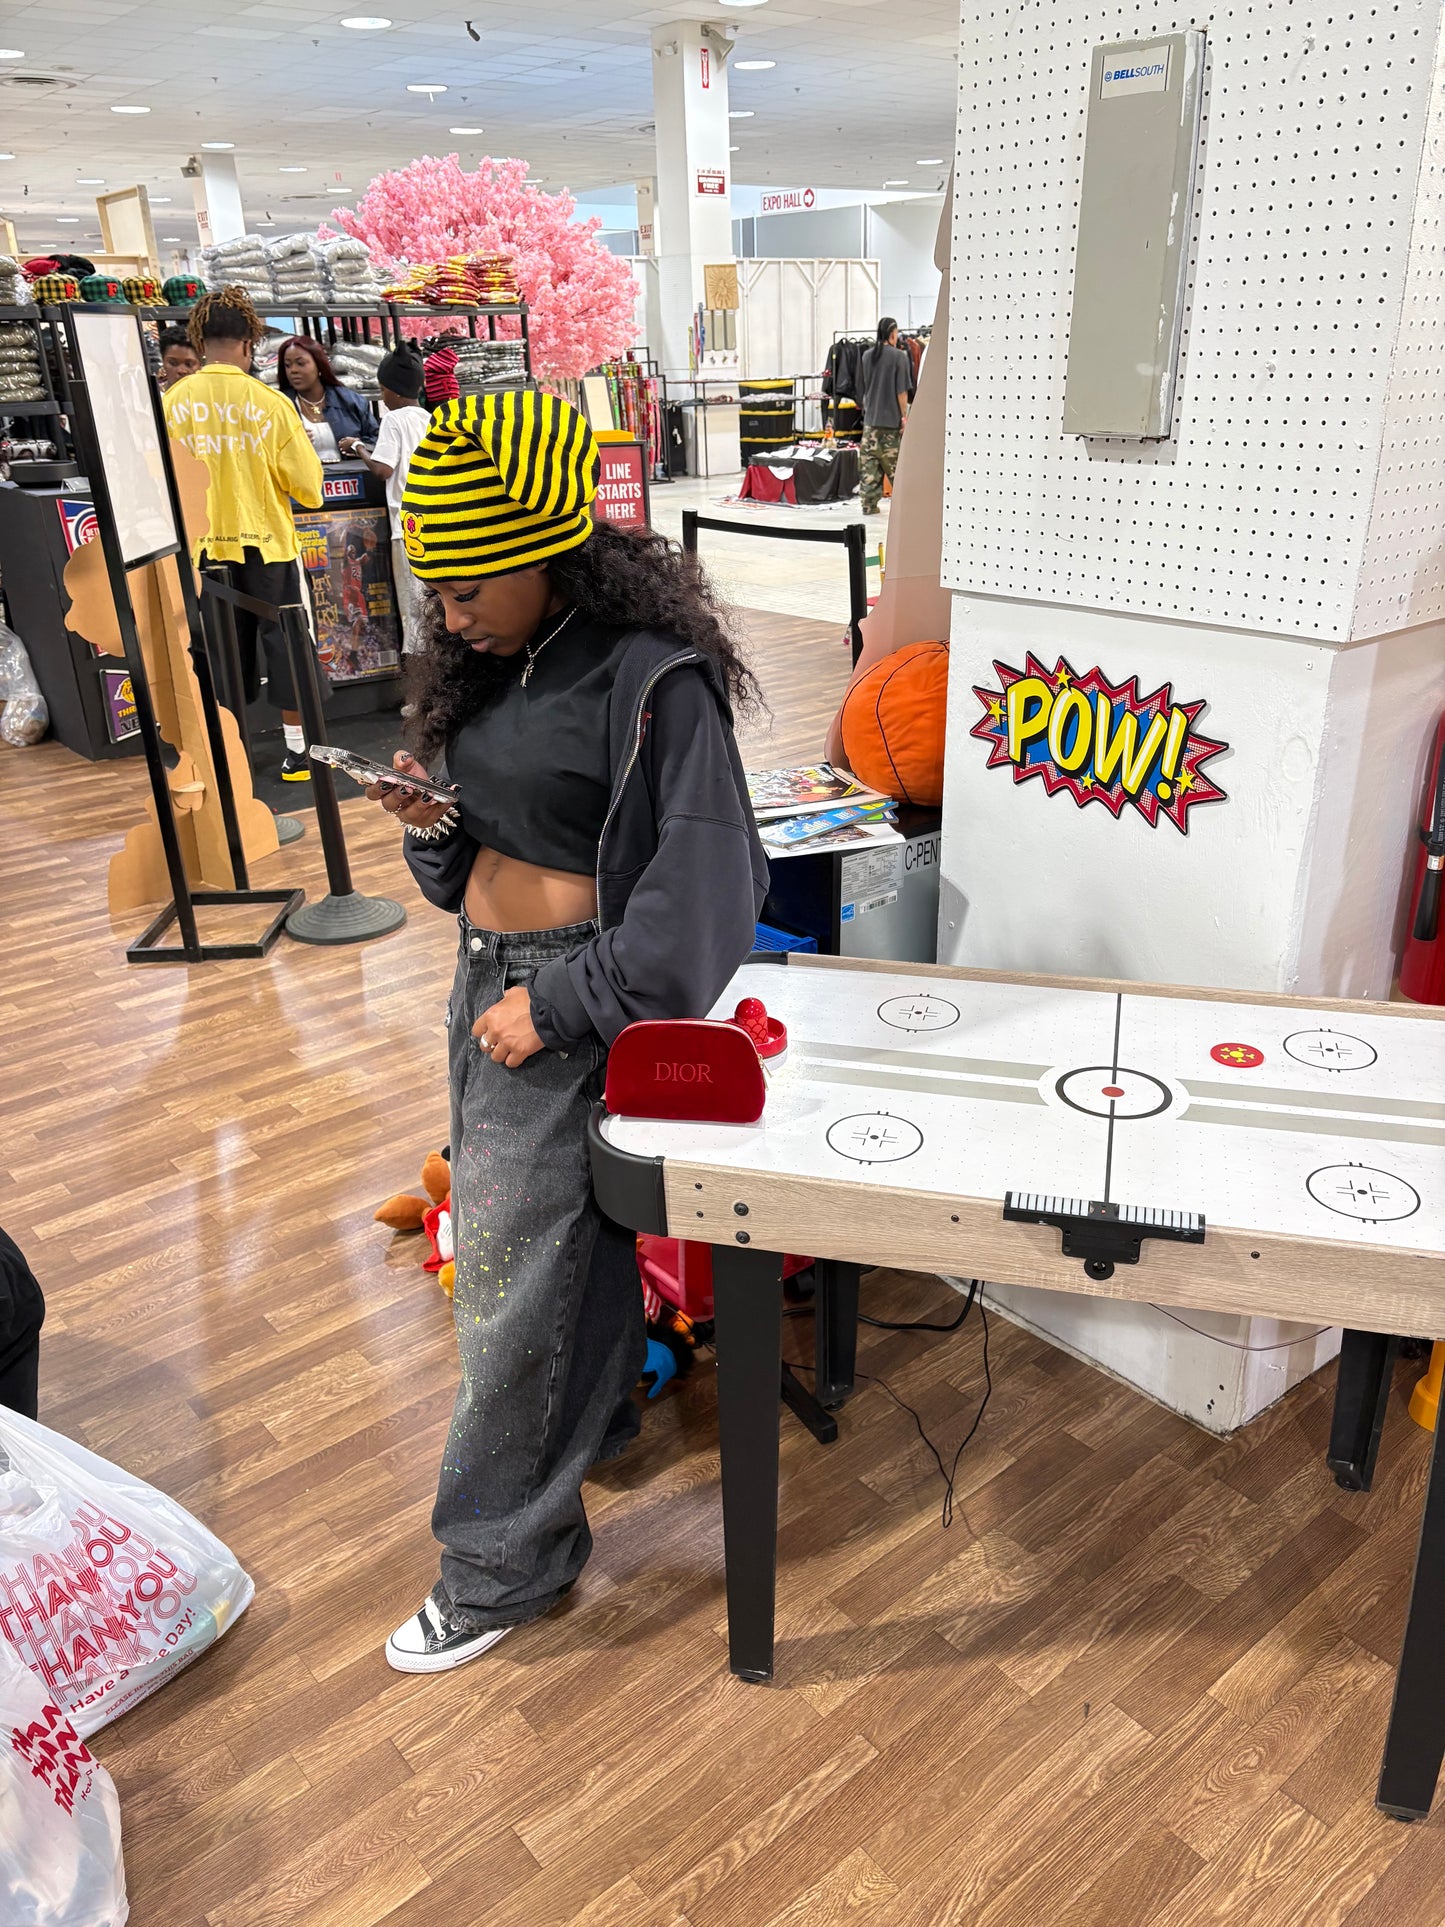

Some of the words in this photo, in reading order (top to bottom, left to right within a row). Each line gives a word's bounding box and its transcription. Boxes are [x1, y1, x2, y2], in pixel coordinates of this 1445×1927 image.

[1113, 64, 1165, 80] BELLSOUTH
[763, 195, 781, 211] EXPO
[784, 192, 802, 209] HALL
[605, 463, 632, 480] LINE
[323, 479, 359, 497] RENT
[598, 482, 642, 500] STARTS
[605, 503, 637, 519] HERE
[1007, 676, 1188, 803] POW!
[653, 1062, 714, 1084] DIOR
[118, 1549, 178, 1621] YOU
[135, 1568, 198, 1638] YOU
[69, 1679, 116, 1714] Have
[119, 1669, 130, 1681] a
[165, 1607, 197, 1647] Day!
